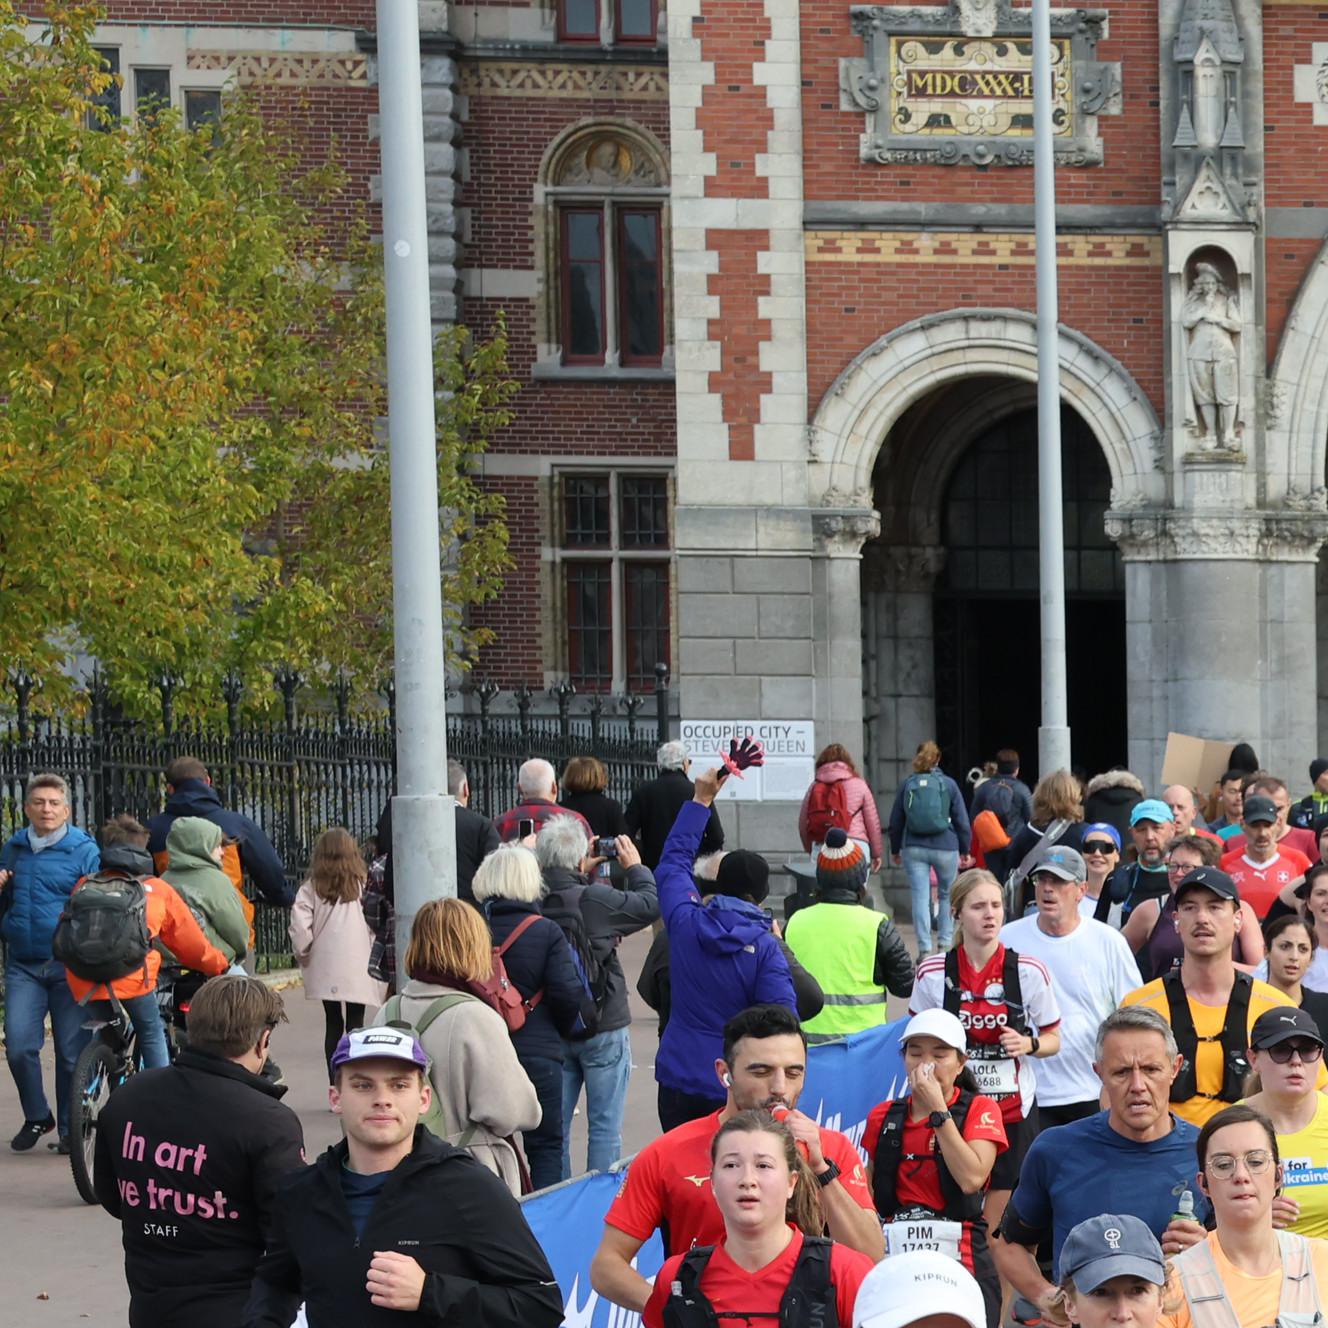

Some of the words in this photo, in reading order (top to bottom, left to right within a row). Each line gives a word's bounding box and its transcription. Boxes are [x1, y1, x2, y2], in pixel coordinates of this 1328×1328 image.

[683, 725, 754, 739] OCCUPIED
[759, 725, 792, 739] CITY
[973, 1064, 997, 1075] LOLA
[122, 1121, 145, 1162] In
[154, 1141, 208, 1177] art
[1288, 1160, 1307, 1170] for
[146, 1178, 240, 1220] trust.
[143, 1223, 179, 1237] STAFF
[907, 1226, 933, 1239] PIM
[913, 1272, 958, 1287] KIPRUN
